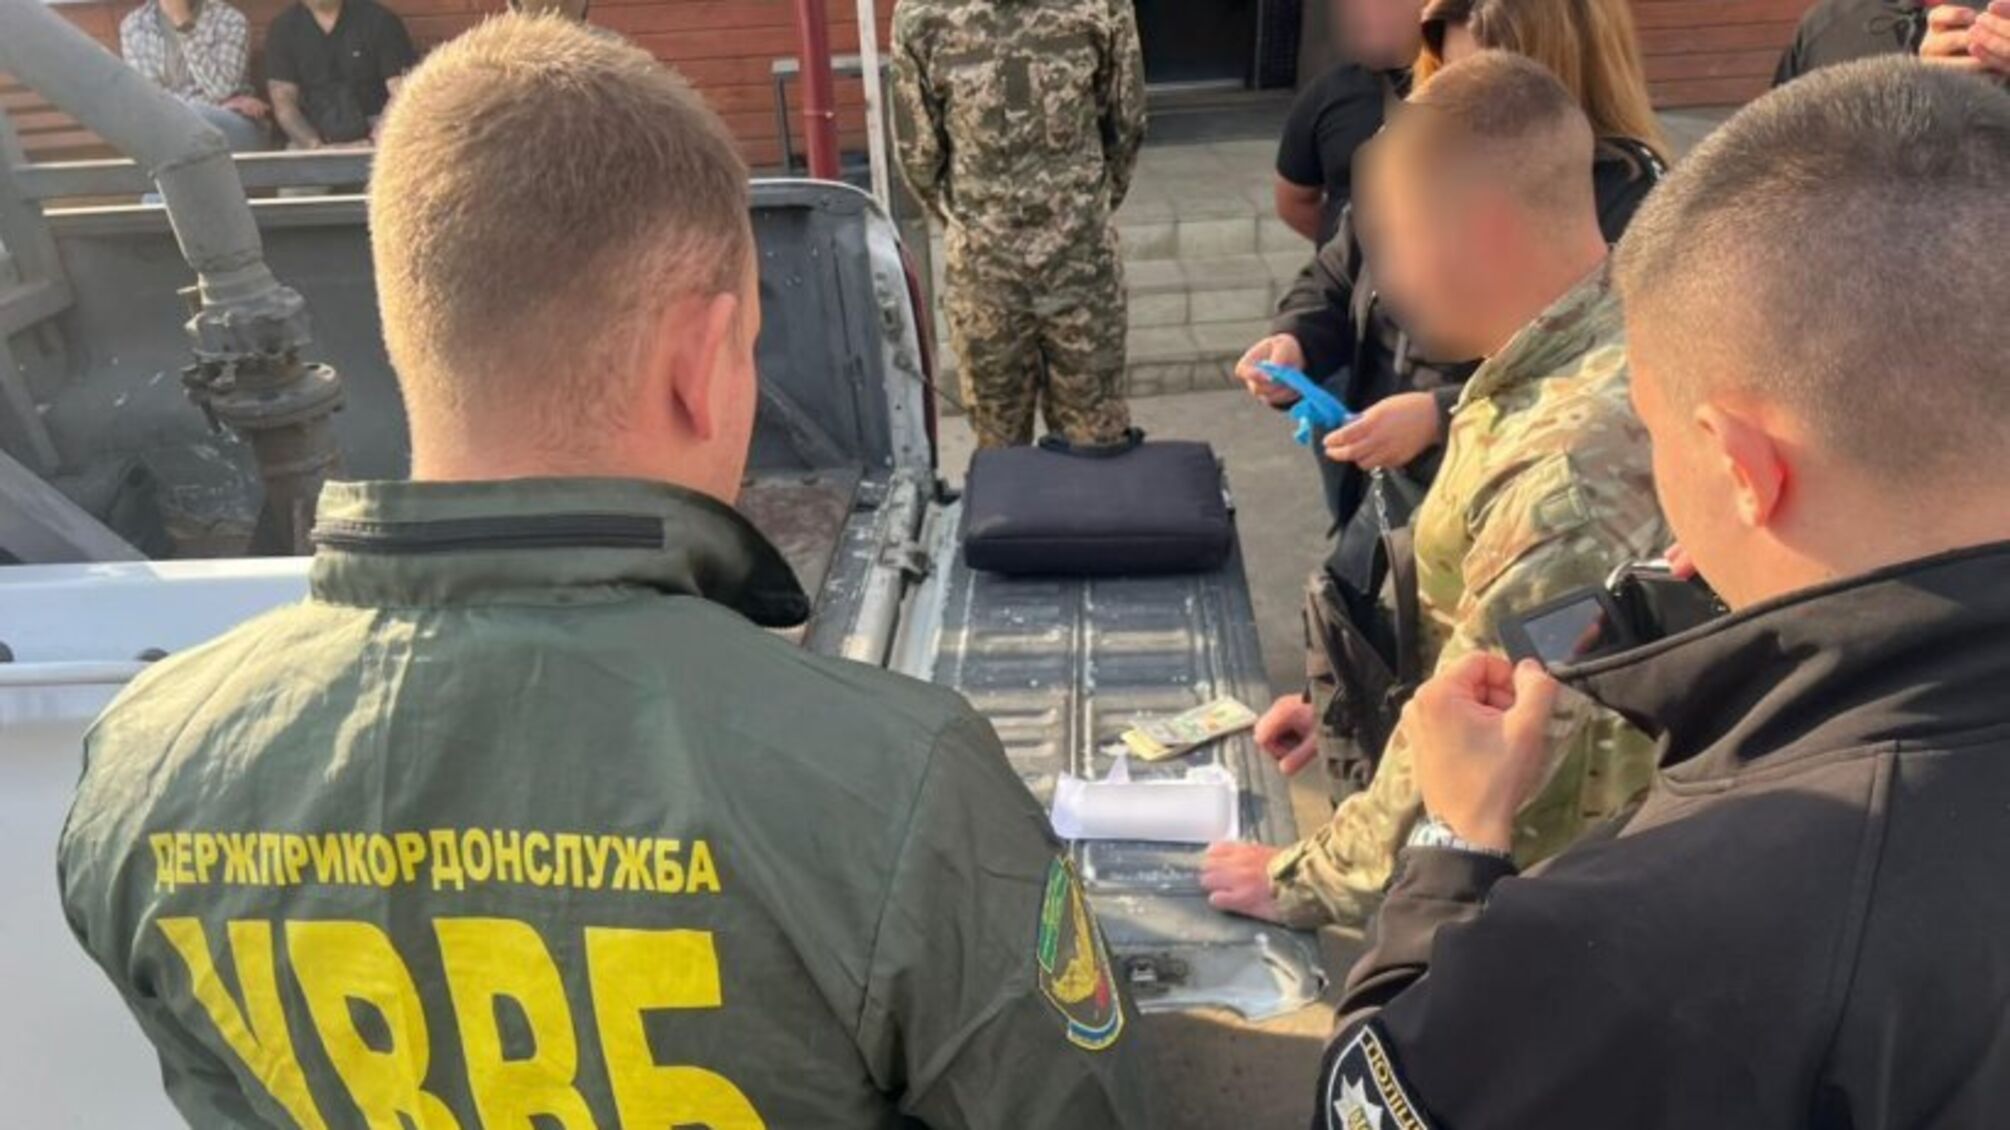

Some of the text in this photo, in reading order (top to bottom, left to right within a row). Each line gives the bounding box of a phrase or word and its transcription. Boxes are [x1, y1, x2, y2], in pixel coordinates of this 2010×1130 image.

[149, 827, 721, 893] ДЕРЖПРИКОРДОНСЛУЖБА
[157, 917, 766, 1130] УВВБ
[1366, 1041, 1422, 1130] ПОЛІЦ
